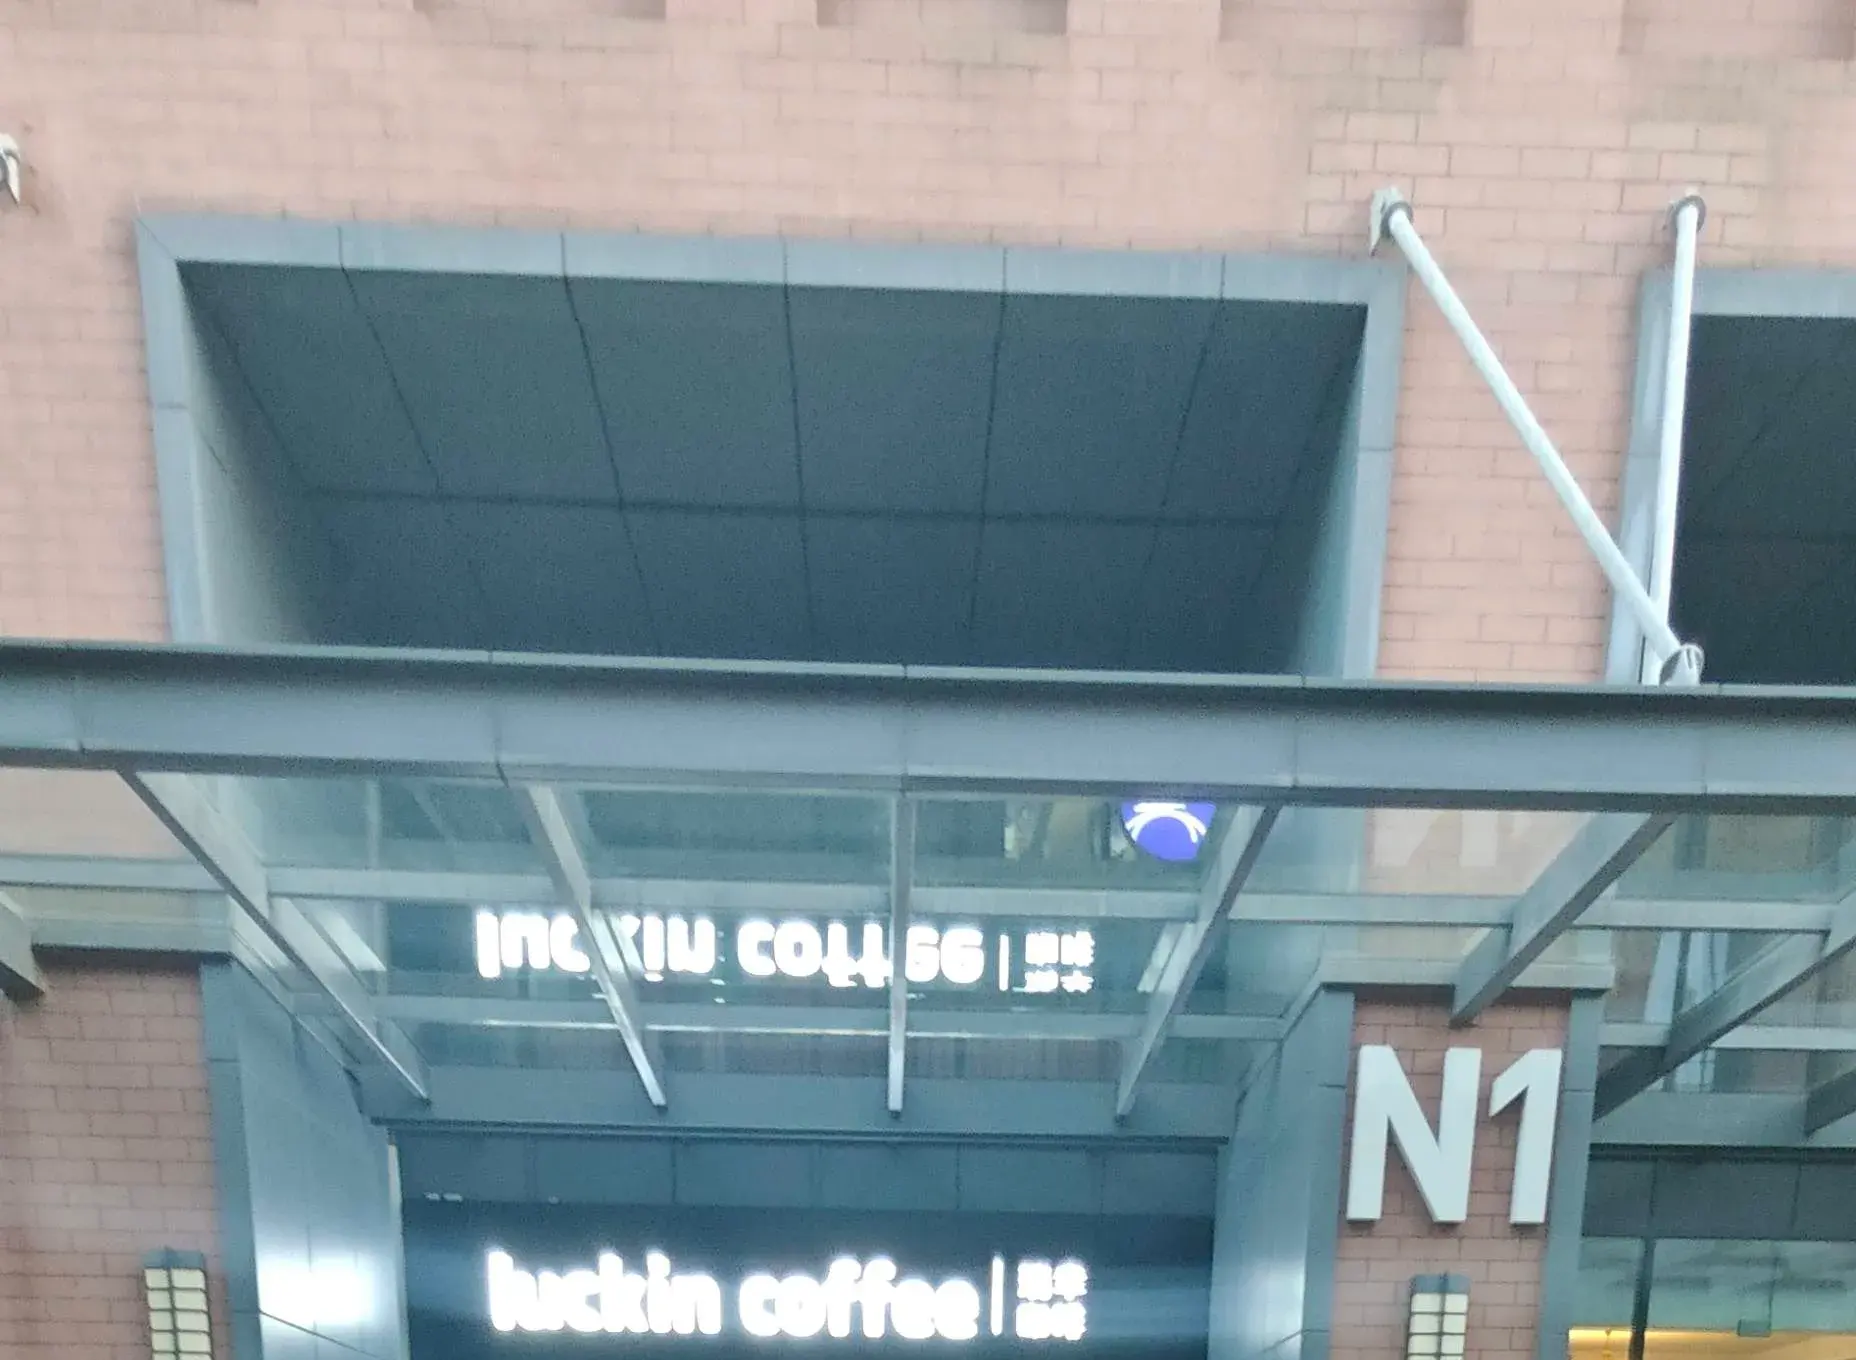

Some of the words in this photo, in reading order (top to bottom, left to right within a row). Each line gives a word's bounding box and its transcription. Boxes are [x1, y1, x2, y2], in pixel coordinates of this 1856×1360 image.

[1347, 1044, 1562, 1225] N1
[486, 1248, 722, 1335] luckin
[738, 1256, 981, 1341] coffee
